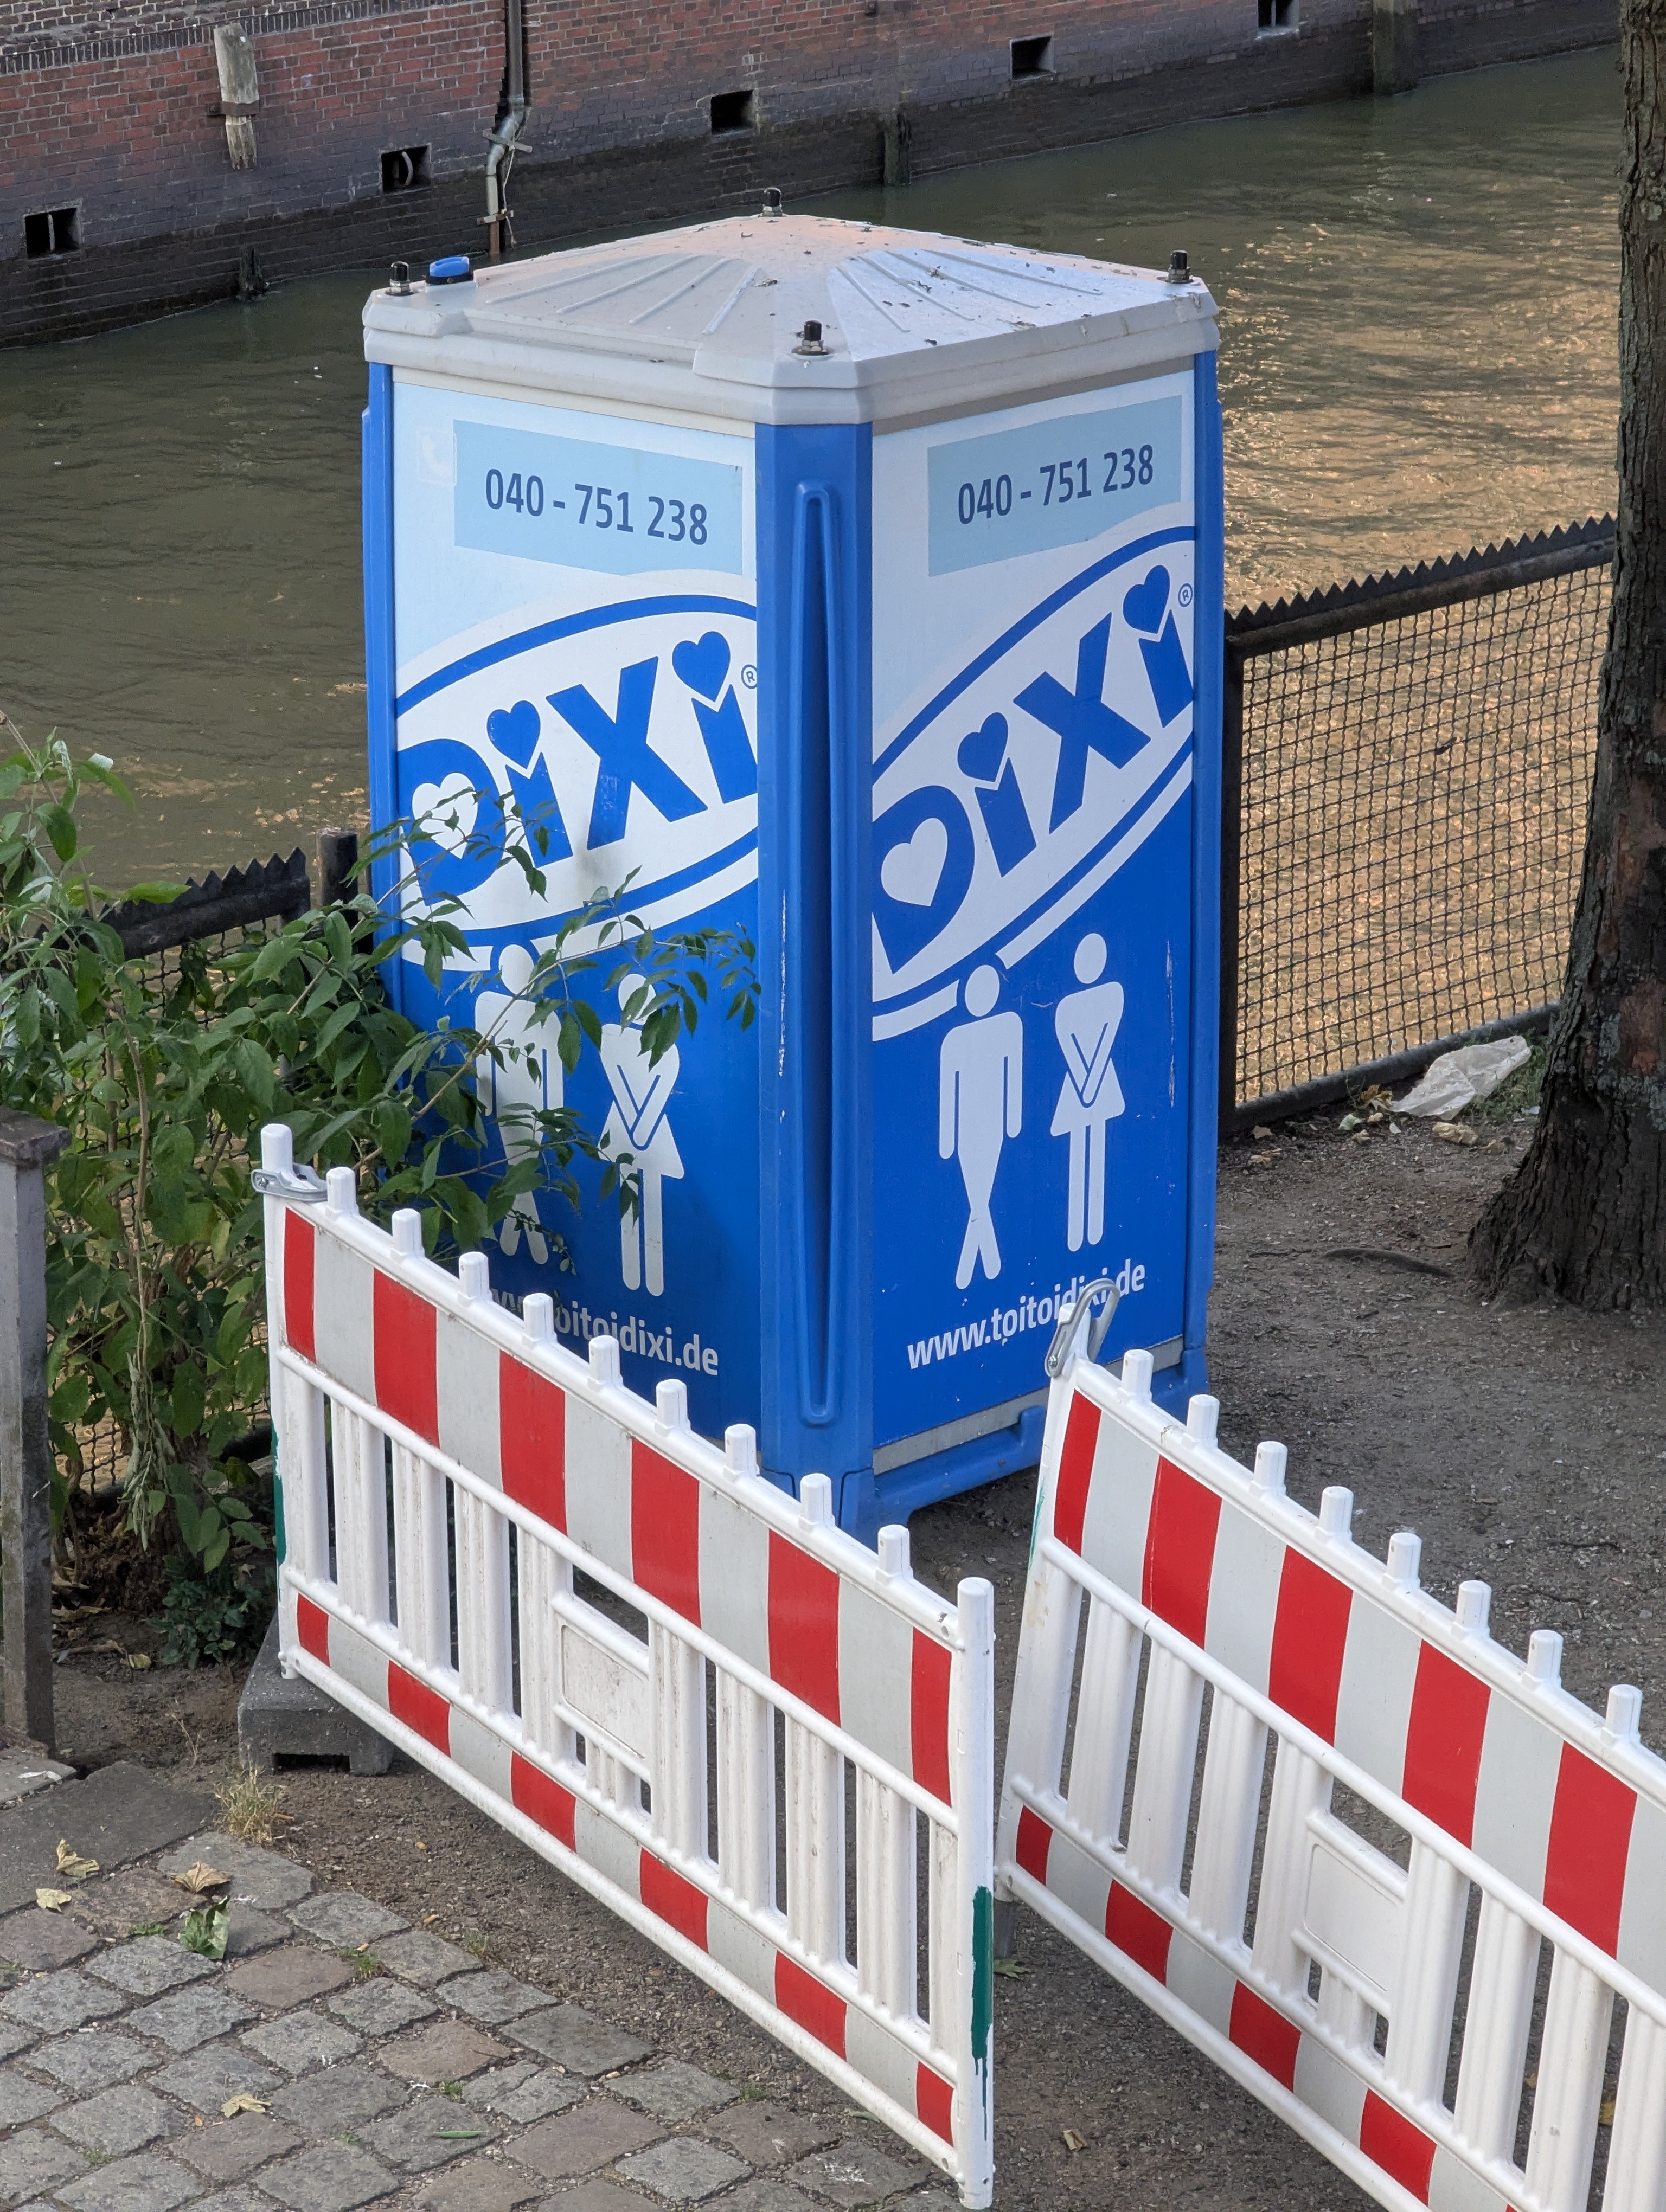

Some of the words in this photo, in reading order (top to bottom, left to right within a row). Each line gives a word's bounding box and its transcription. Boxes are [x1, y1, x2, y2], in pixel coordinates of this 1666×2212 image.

[486, 468, 544, 517] 040
[574, 483, 634, 533] 751
[647, 496, 707, 545] 238
[958, 474, 1012, 525] 040
[1040, 458, 1092, 506] 751
[1103, 444, 1153, 493] 238
